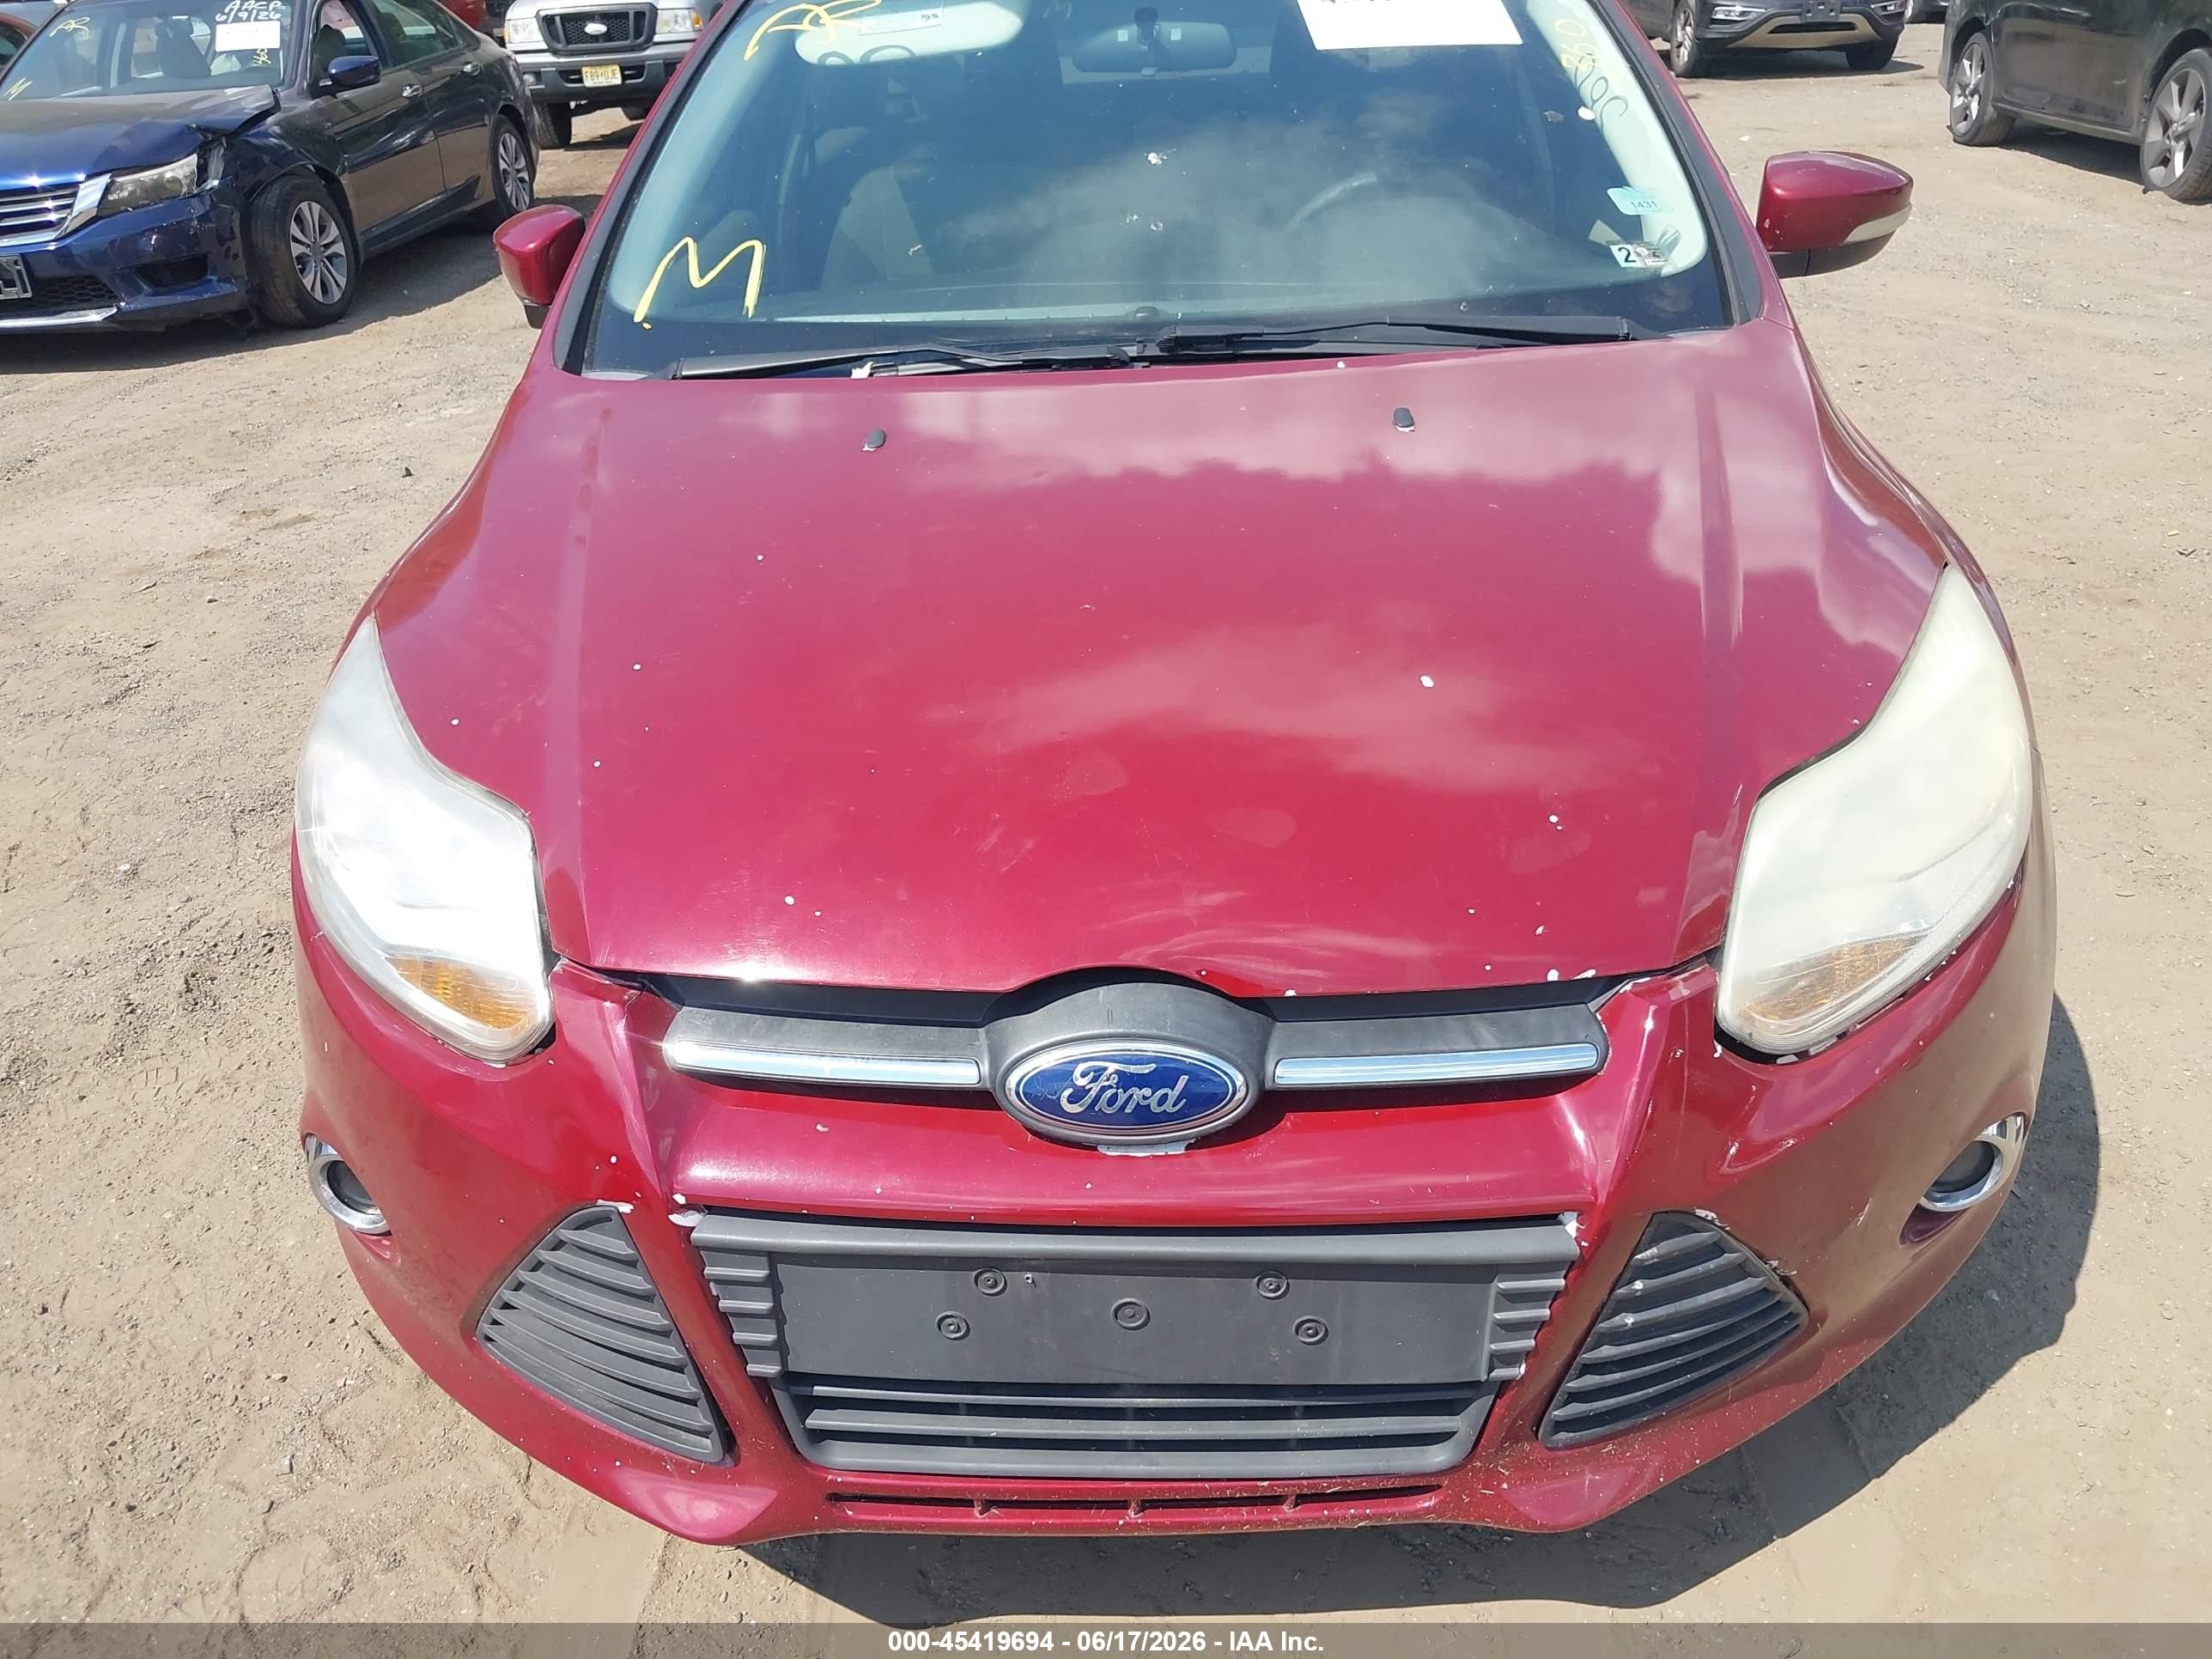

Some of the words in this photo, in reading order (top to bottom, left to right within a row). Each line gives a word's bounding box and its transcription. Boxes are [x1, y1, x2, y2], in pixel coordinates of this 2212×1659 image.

[1631, 200, 1658, 210] 1431
[633, 236, 767, 331] M
[1060, 1060, 1188, 1114] Ford
